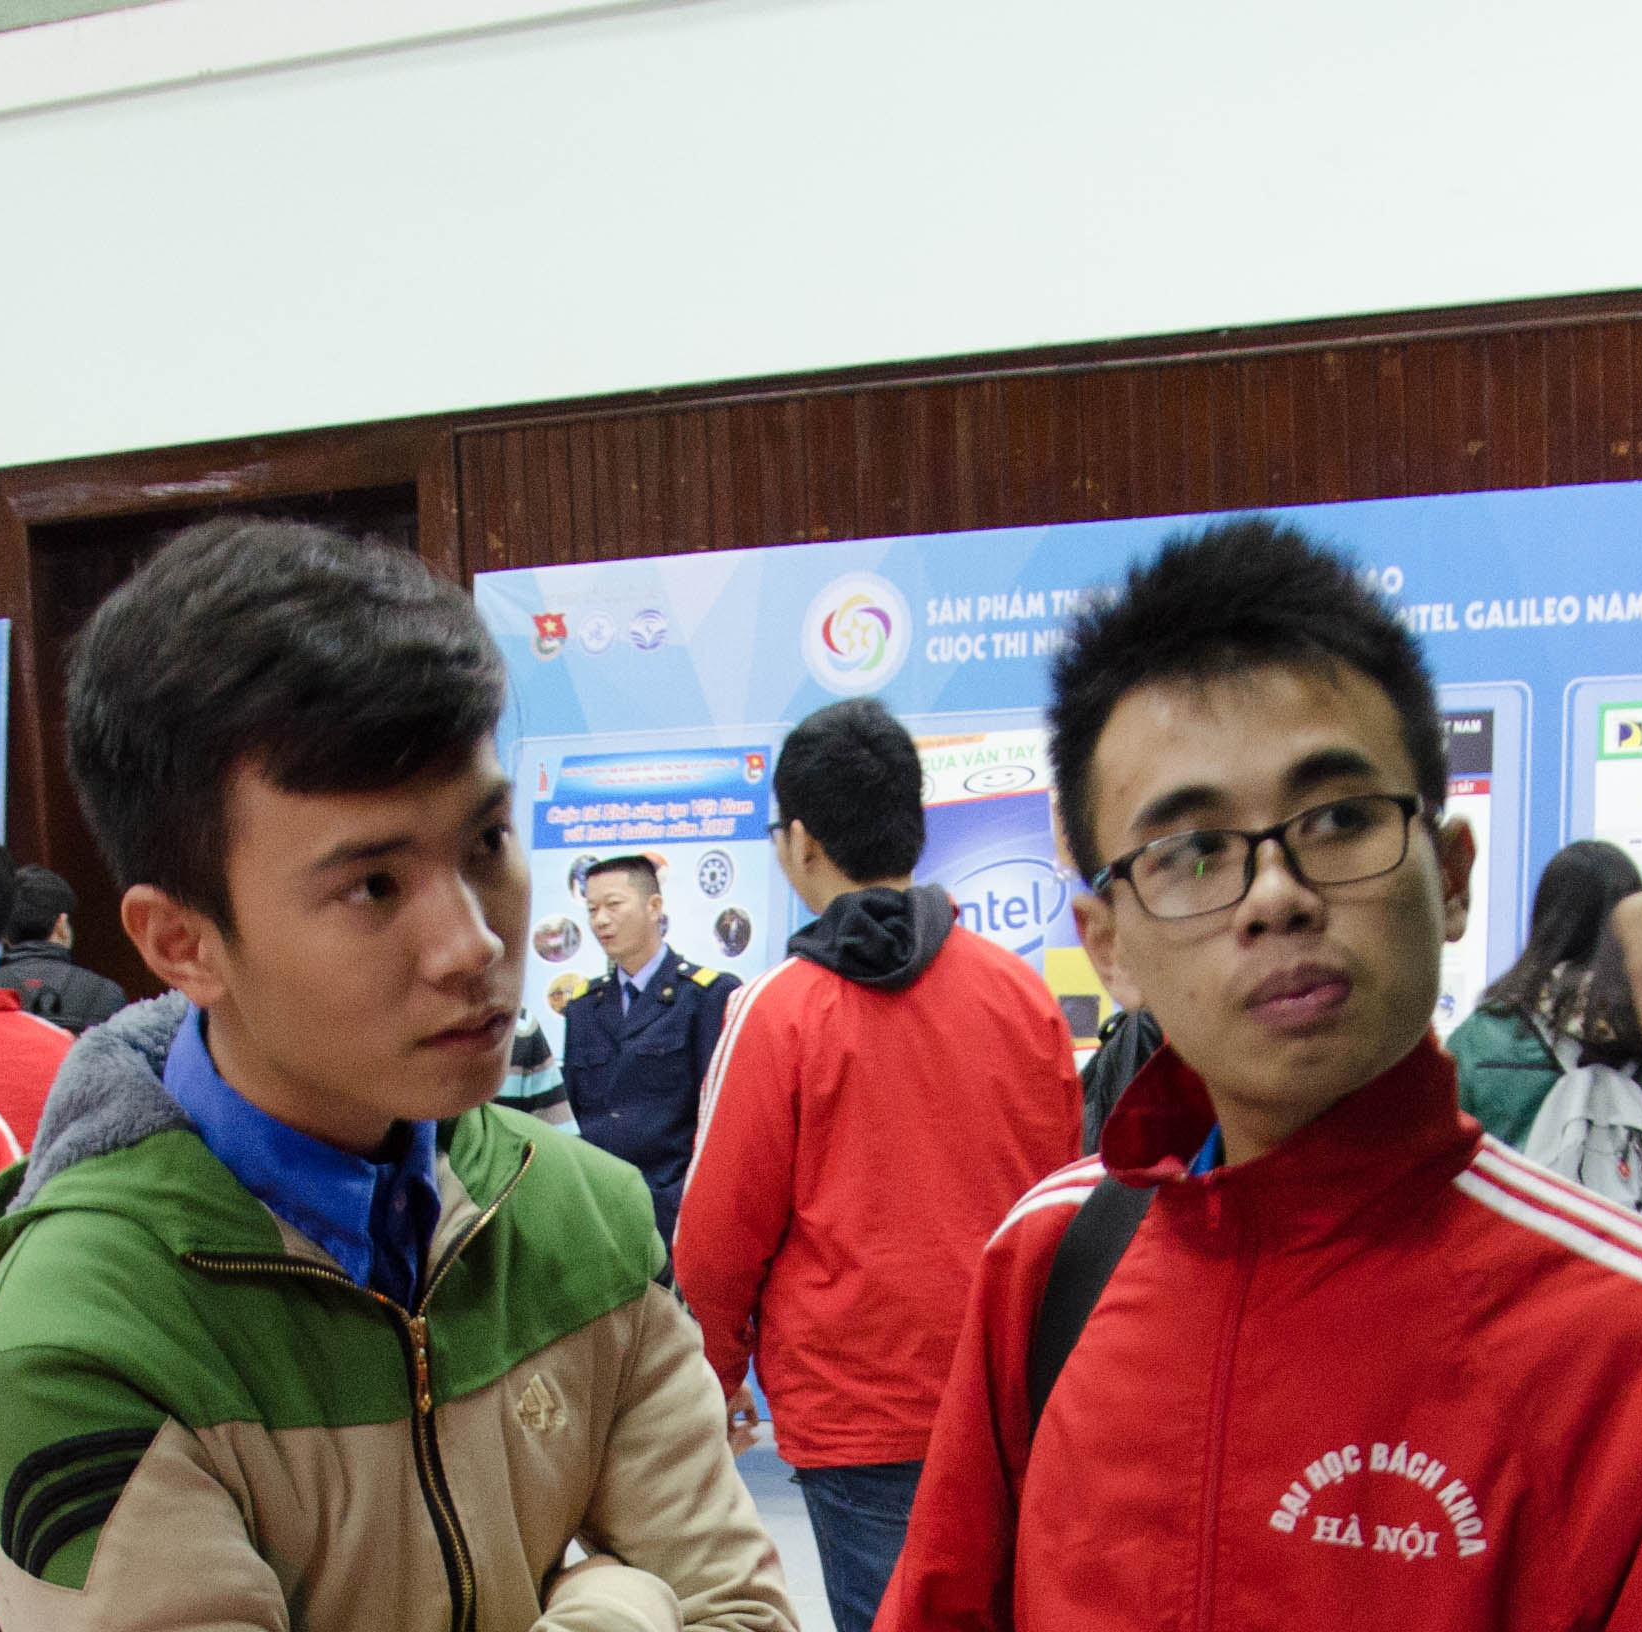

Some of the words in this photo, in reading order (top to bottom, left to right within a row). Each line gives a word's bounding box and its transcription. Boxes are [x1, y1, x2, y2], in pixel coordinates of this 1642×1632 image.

[926, 633, 987, 664] CUỘC
[992, 631, 1028, 660] THI
[1464, 598, 1581, 632] GALILEO
[1453, 718, 1482, 734] NAM
[1004, 743, 1038, 763] TAY
[959, 880, 1041, 934] ntel
[1303, 1443, 1363, 1492] HỌC
[1368, 1439, 1448, 1491] BÁCH
[1435, 1477, 1489, 1559] KHOA
[1371, 1520, 1441, 1563] NỘI
